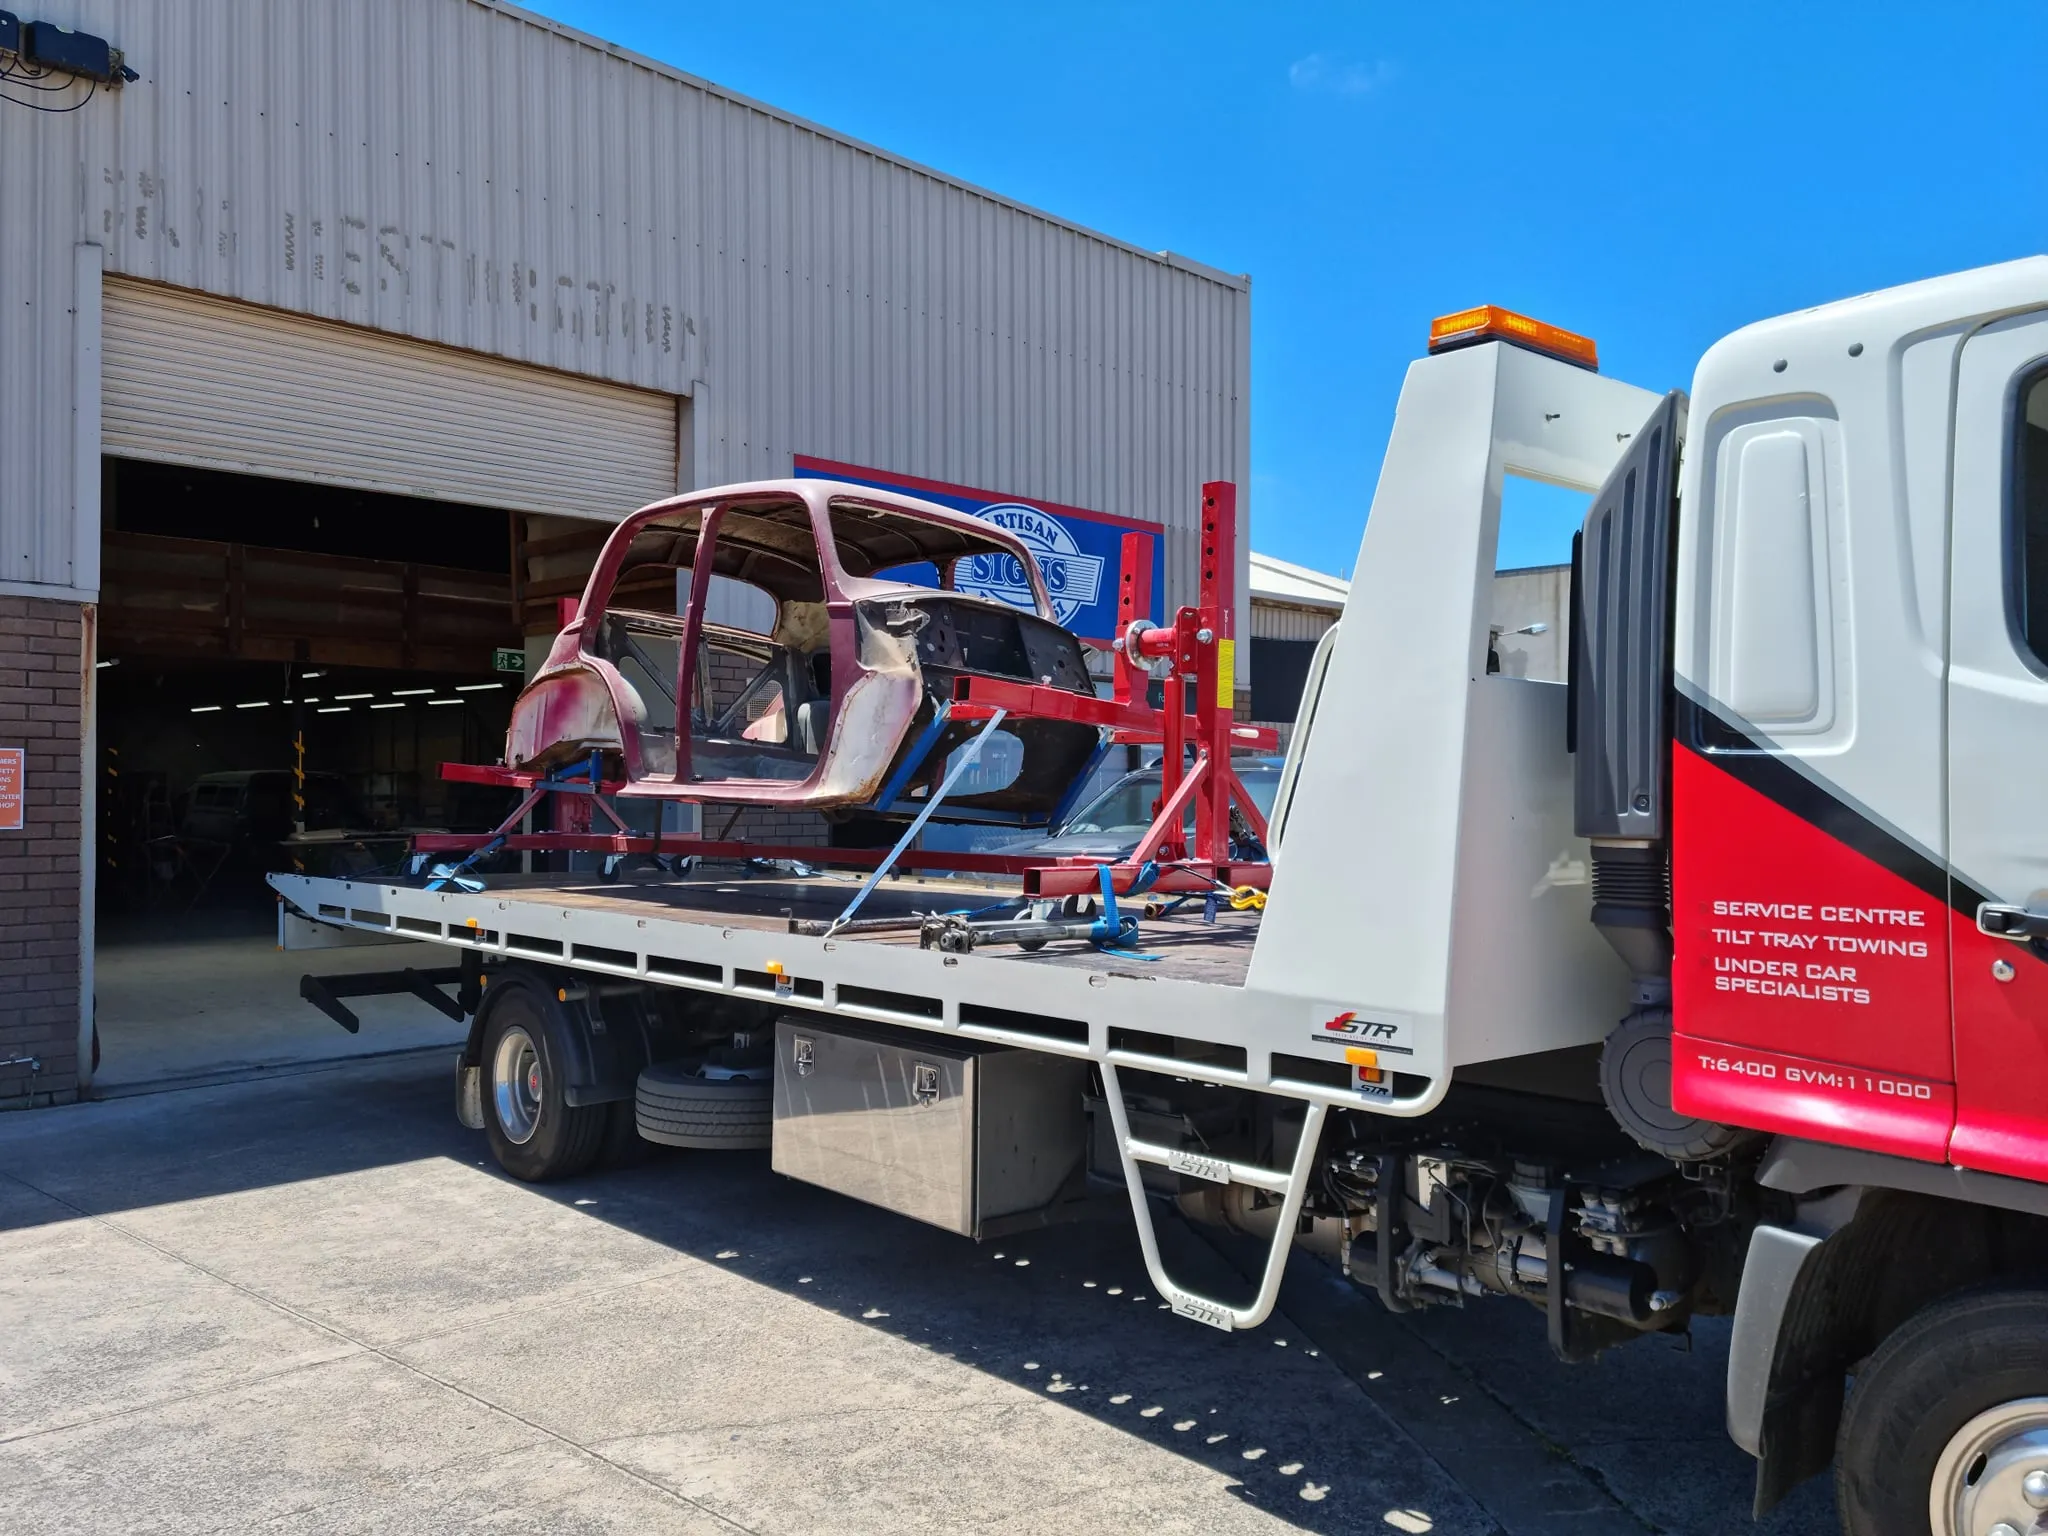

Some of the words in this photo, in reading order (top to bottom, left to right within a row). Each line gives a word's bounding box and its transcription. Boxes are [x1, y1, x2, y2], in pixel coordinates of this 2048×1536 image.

[984, 512, 1058, 546] RTISAN
[1713, 901, 1812, 920] SERVICE
[1820, 907, 1925, 927] CENTRE
[1711, 928, 1755, 945] TILT
[1758, 931, 1819, 949] TRAY
[1823, 935, 1928, 958] TOWING
[1714, 956, 1798, 977] UNDER
[1805, 964, 1857, 982] CAR
[1715, 976, 1870, 1004] SPECIALISTS
[1328, 1020, 1399, 1039] STR
[1355, 1084, 1389, 1095] STR
[1698, 1055, 1776, 1078] T:6400
[1785, 1067, 1931, 1099] GVM:11000
[1176, 1304, 1225, 1324] STR
